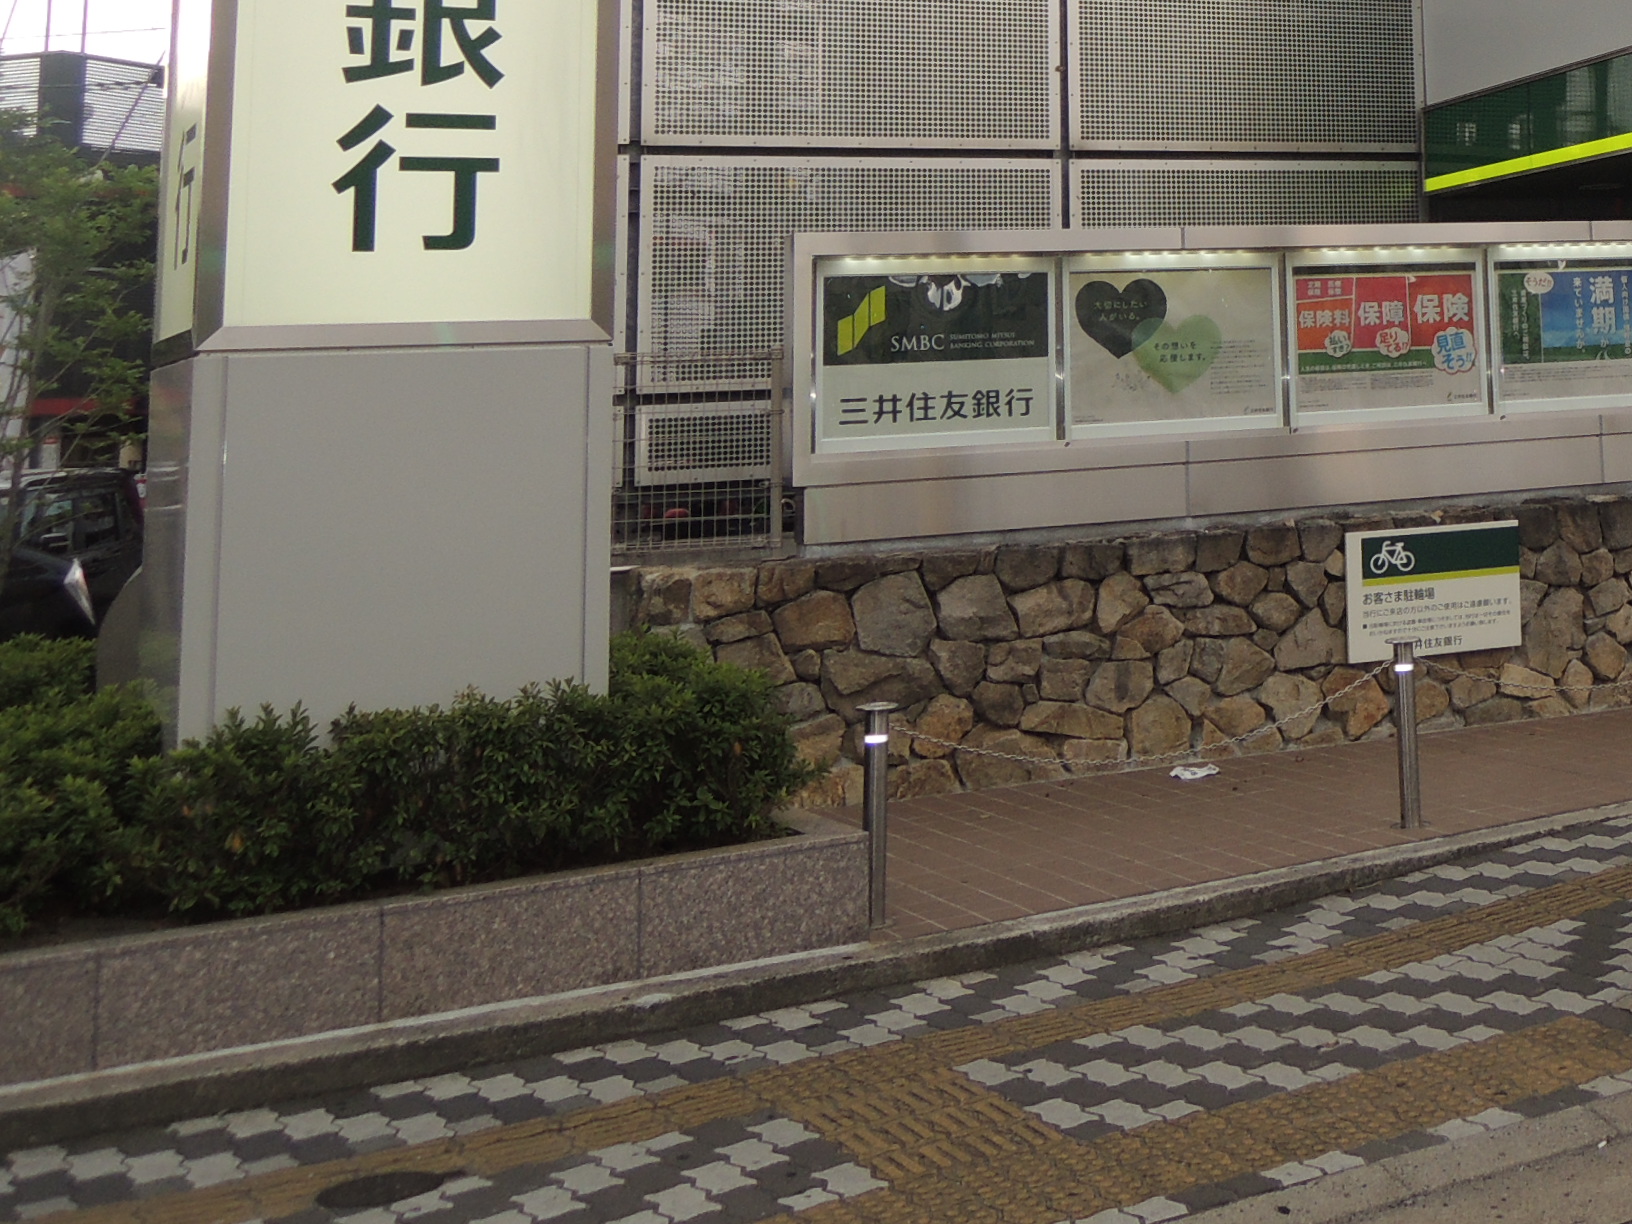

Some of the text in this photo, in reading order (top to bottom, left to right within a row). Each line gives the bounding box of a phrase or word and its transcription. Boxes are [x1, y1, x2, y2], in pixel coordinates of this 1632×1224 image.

[1357, 300, 1405, 326] 保障
[1413, 292, 1470, 324] 保険
[1299, 309, 1350, 329] 保険料
[890, 333, 945, 353] SMBC
[838, 388, 1034, 426] 三井住友銀行
[1362, 587, 1435, 606] お客さま駐輪場
[1414, 635, 1463, 650] 井住友銀行
